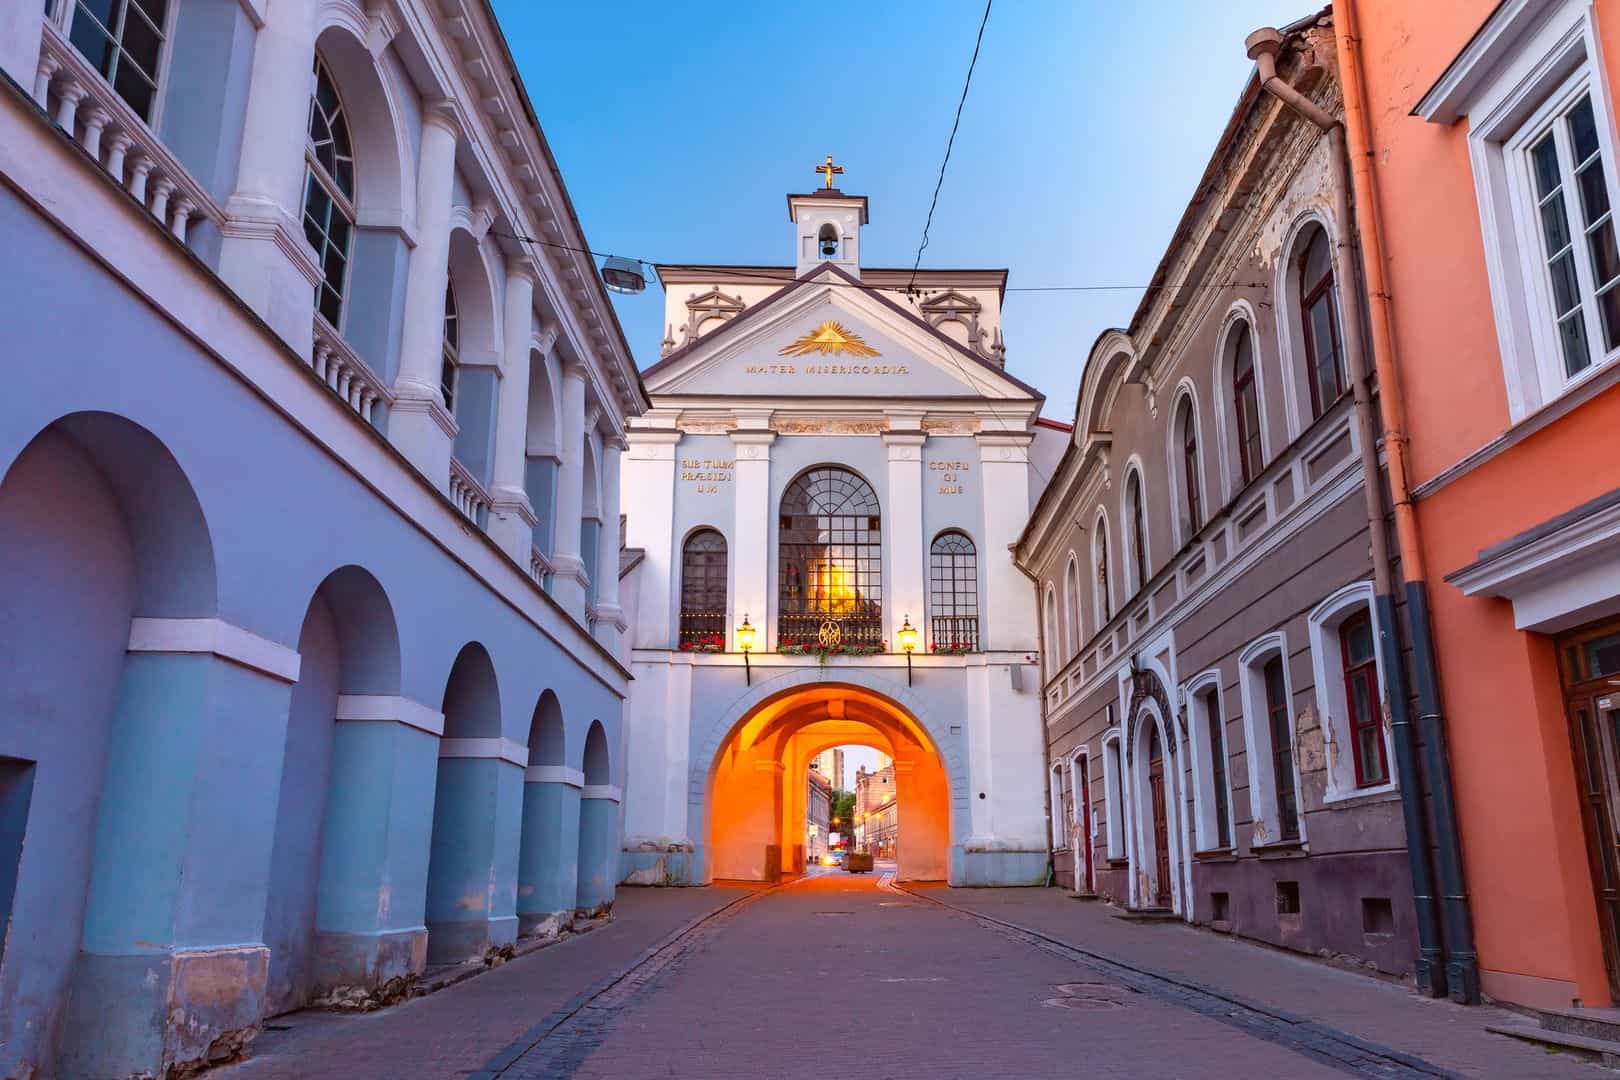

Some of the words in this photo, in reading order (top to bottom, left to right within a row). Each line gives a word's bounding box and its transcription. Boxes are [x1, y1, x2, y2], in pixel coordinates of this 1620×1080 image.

[746, 365, 796, 375] MATER
[805, 365, 910, 375] MISERICORDIA
[681, 459, 701, 469] SUB
[929, 461, 969, 470] CONFU
[697, 484, 718, 493] UM
